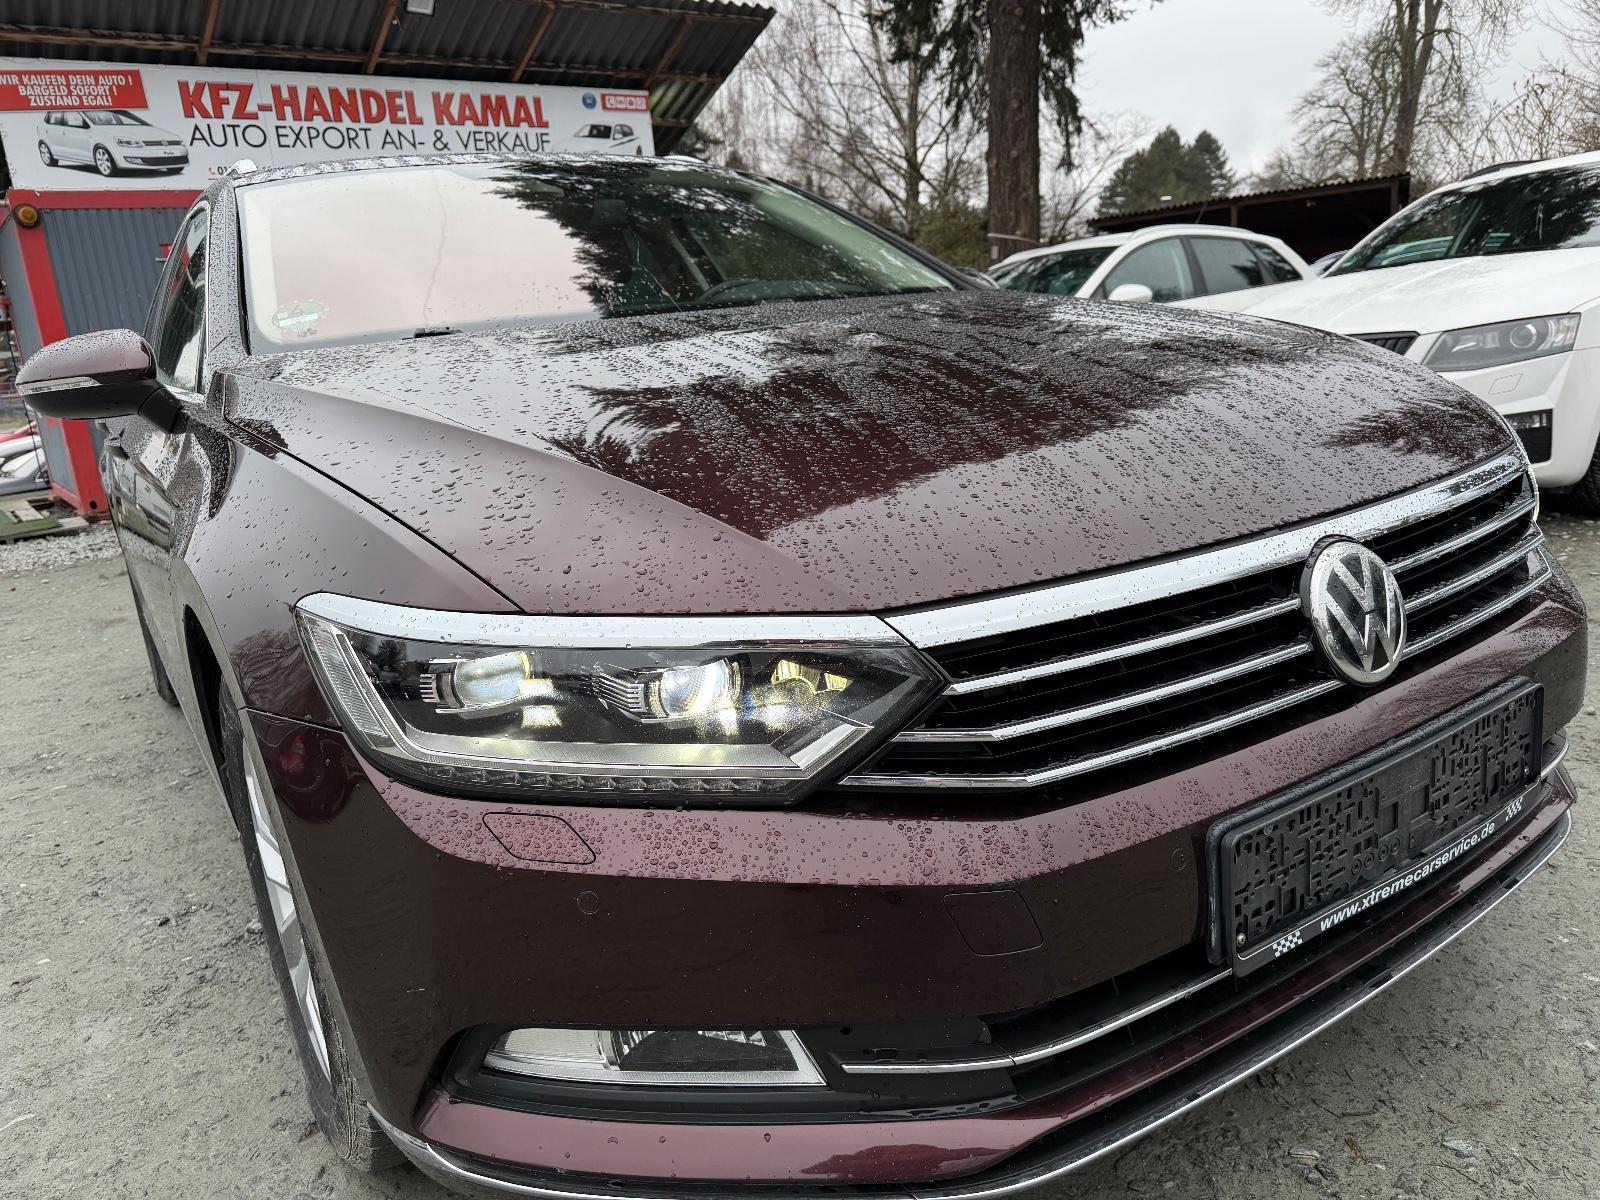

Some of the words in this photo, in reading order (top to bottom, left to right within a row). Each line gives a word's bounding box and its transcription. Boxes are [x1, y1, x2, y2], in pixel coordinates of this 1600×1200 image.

[18, 85, 67, 96] BARGELD
[71, 86, 110, 96] SOFORT
[22, 75, 66, 85] KAUFEN
[69, 75, 95, 85] DEIN
[98, 75, 126, 86] AUTO
[28, 95, 79, 107] ZUSTAND
[82, 96, 113, 106] EGAL!
[177, 80, 424, 125] KFZ-HANDEL
[431, 91, 549, 128] KAMAL
[190, 123, 267, 147] AUTO
[274, 125, 371, 149] EXPORT
[381, 128, 425, 151] AN-
[432, 129, 451, 151] &
[456, 130, 551, 152] VERKAUF
[1319, 822, 1496, 932] www.xtremecarservice.de
